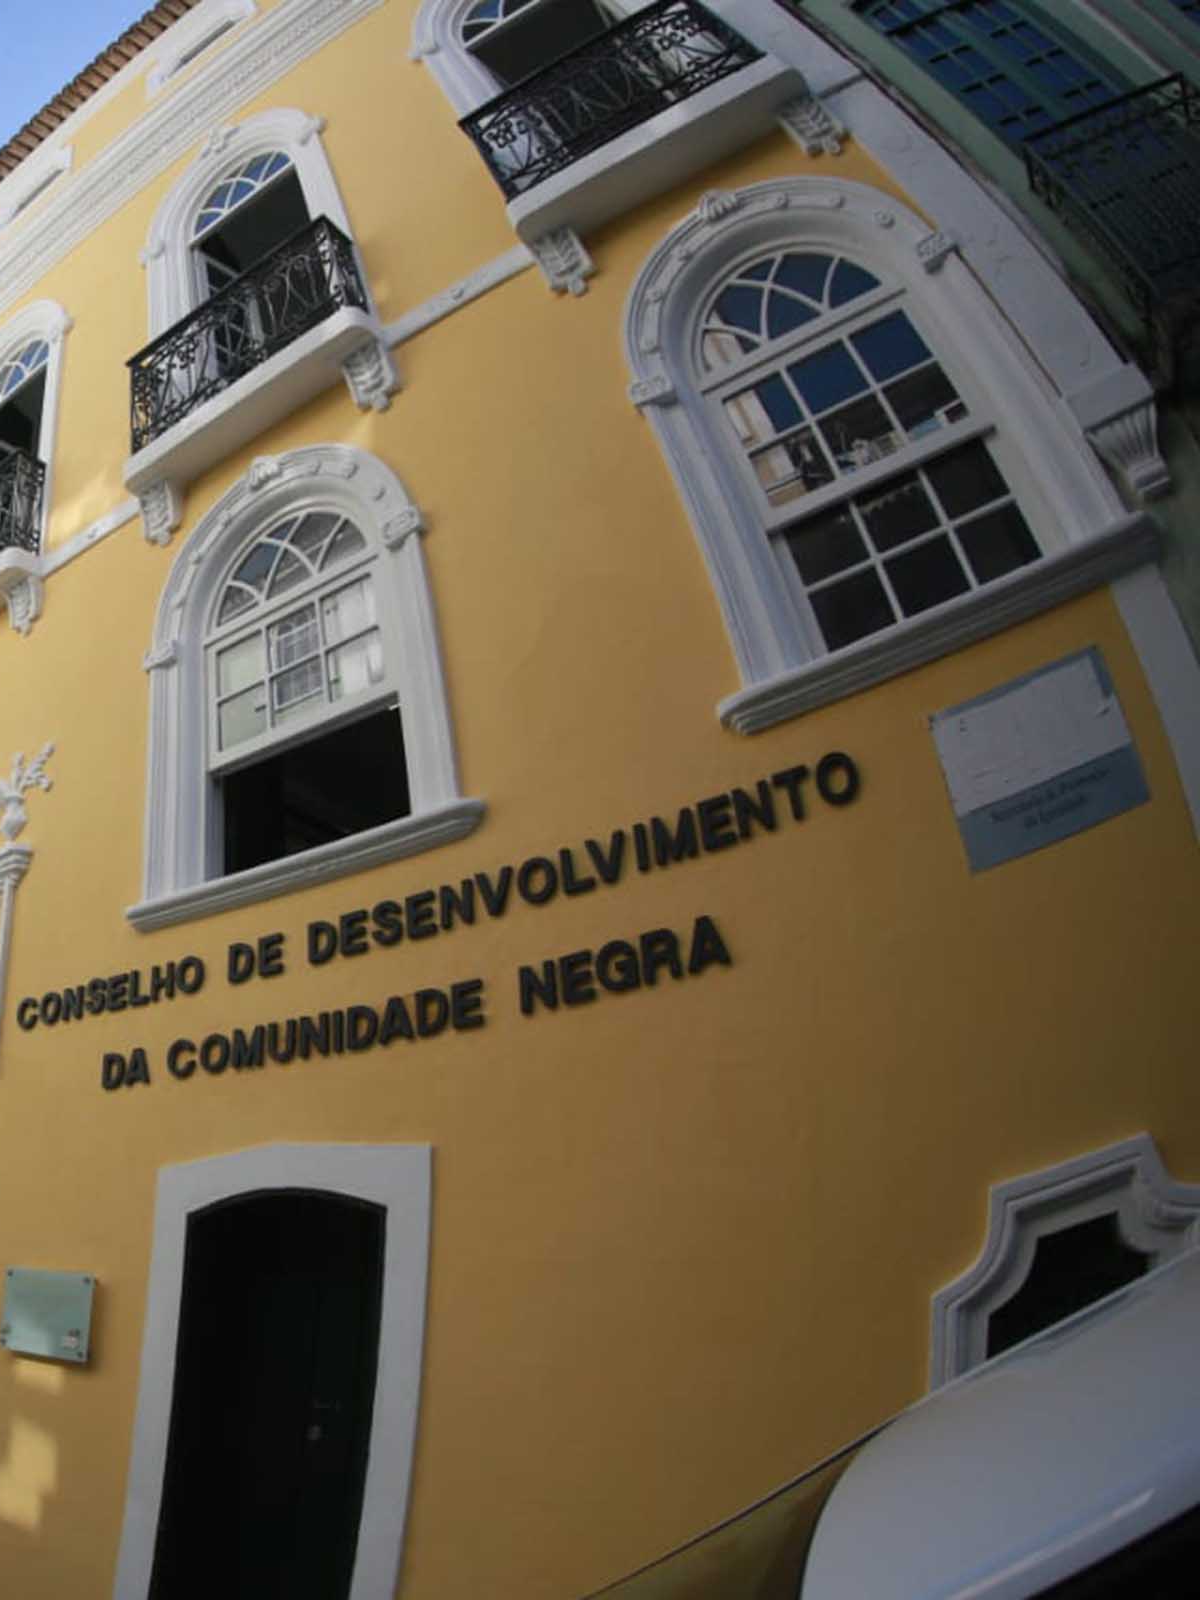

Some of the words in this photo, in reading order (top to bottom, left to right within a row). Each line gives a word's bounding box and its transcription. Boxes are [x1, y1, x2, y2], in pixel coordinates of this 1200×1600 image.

[17, 955, 206, 1031] CONSELHO
[228, 932, 286, 985] DE
[307, 751, 862, 966] DESENVOLVIMENTO
[102, 1047, 151, 1091] DA
[167, 978, 486, 1080] COMUNIDADE
[519, 915, 733, 1017] NEGRA
